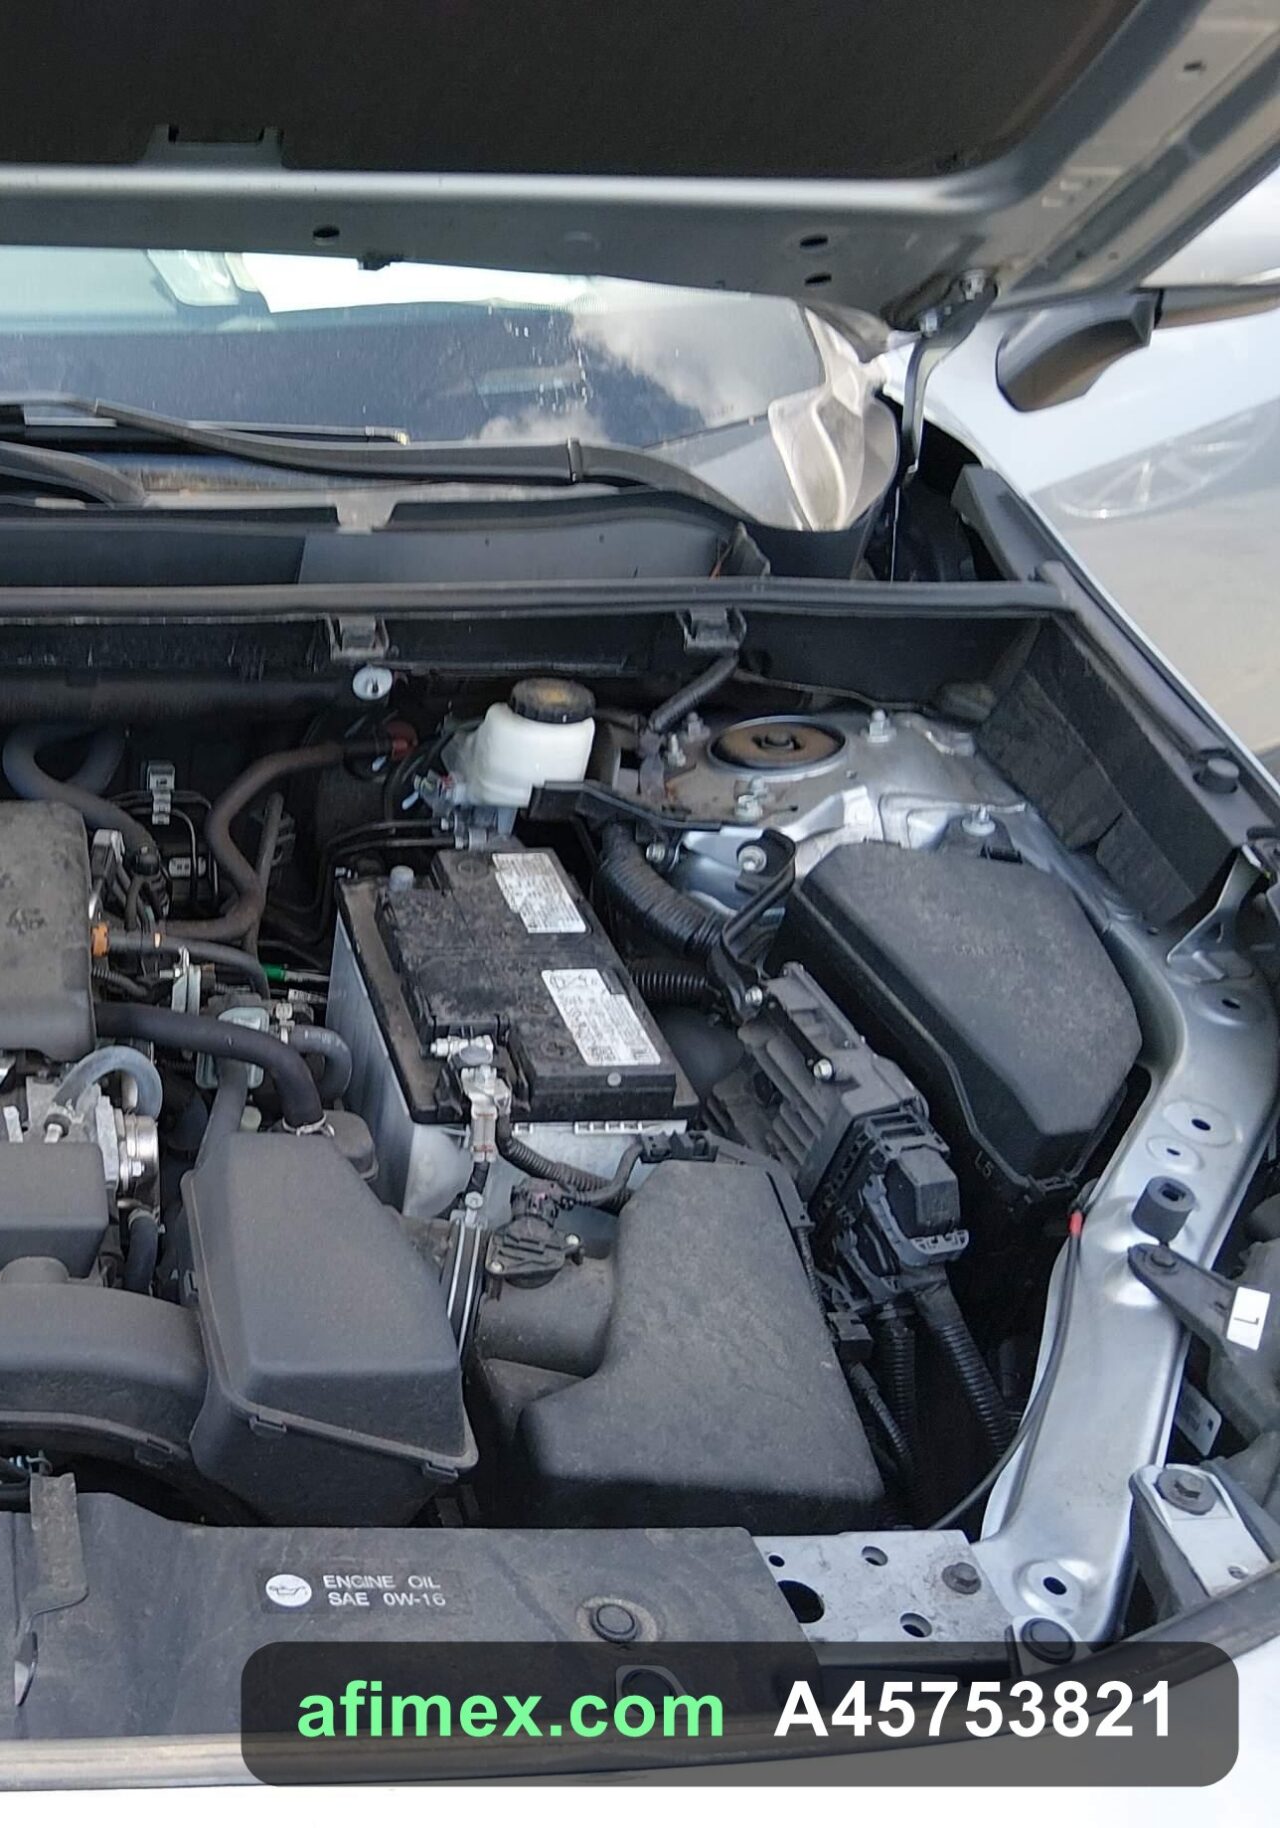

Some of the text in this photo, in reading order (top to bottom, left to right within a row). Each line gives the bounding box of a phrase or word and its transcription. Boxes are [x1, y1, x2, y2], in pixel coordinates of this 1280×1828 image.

[1233, 1316, 1260, 1326] L
[322, 1574, 442, 1589] ENGINE OIL
[327, 1591, 447, 1607] SAE 0W-16
